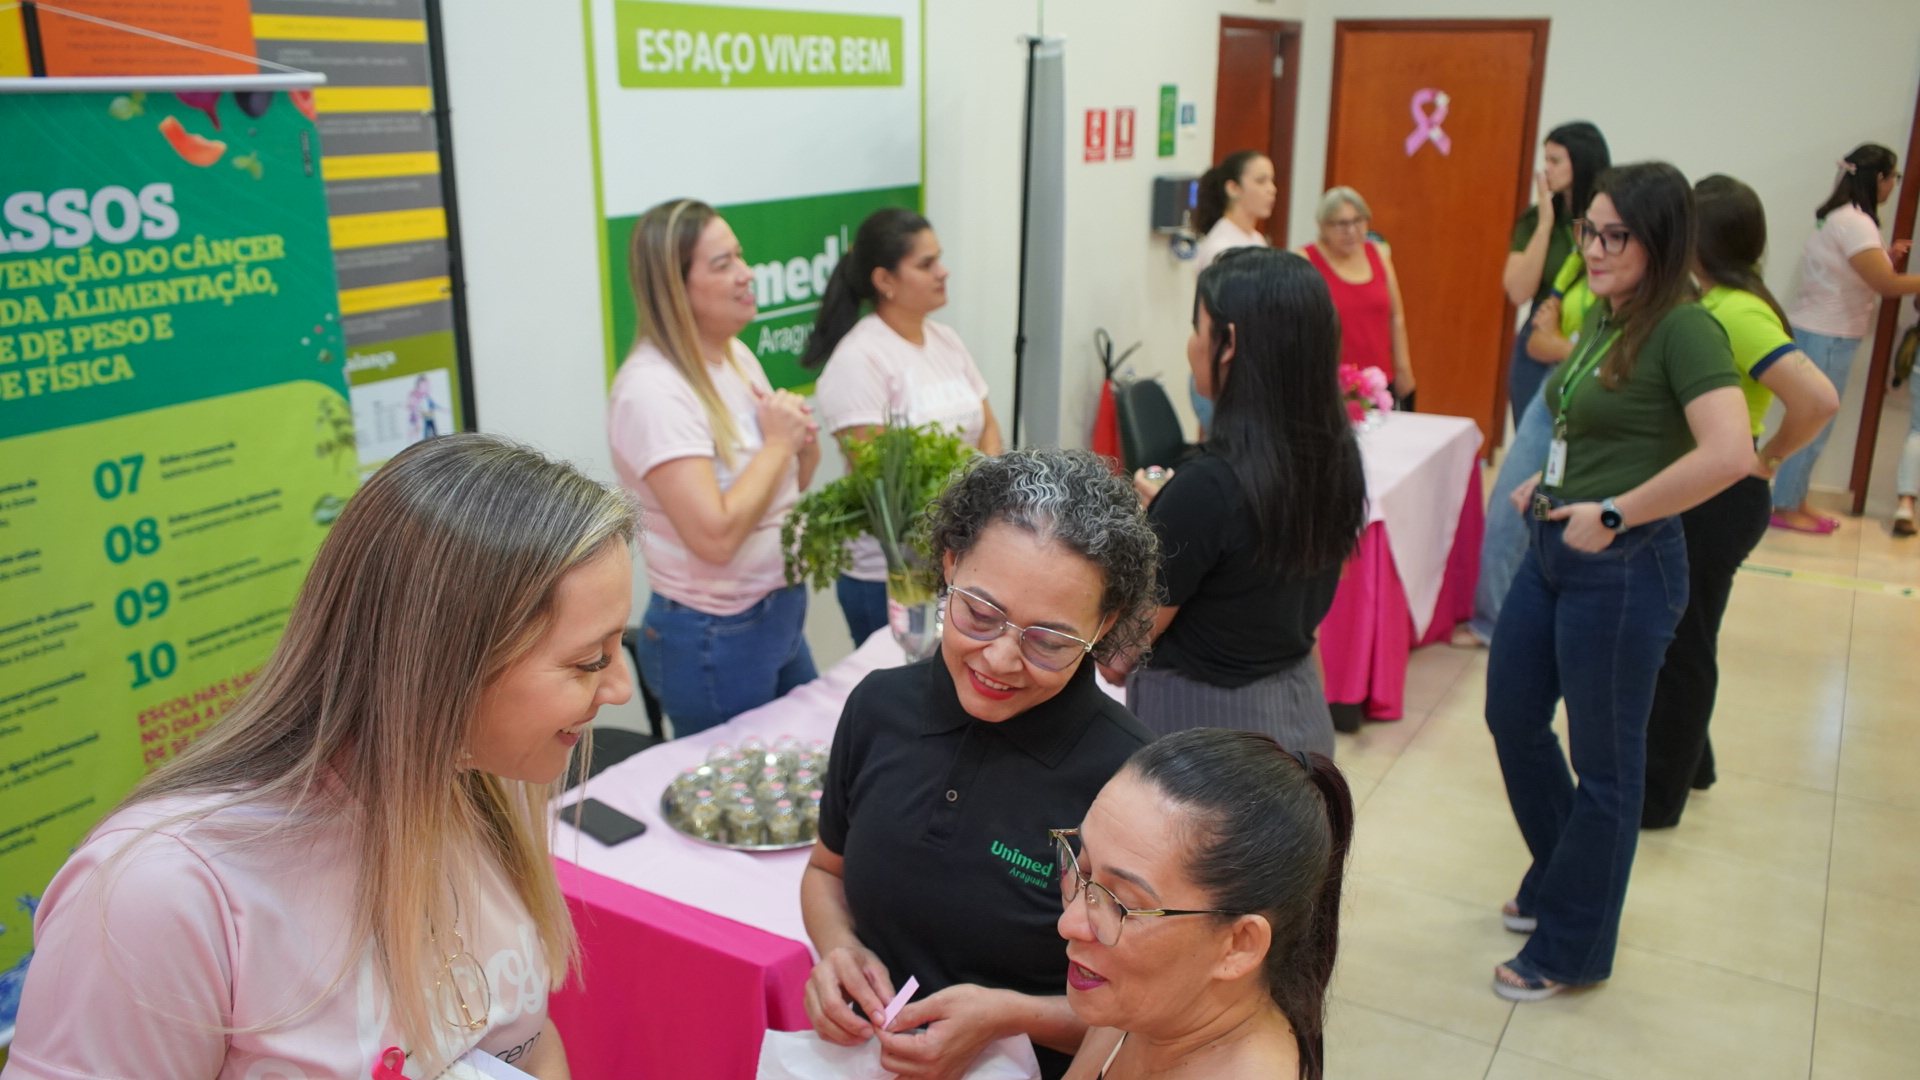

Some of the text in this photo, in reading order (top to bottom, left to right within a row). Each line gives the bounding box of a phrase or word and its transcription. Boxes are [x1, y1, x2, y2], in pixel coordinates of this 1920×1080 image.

[637, 28, 892, 86] ESPAÇO VIVER BEM
[0, 182, 180, 253] SSOS
[0, 234, 286, 292] ENÇÃO DO CÂNCER
[53, 264, 279, 321] ALIMENTAÇÃO,
[19, 328, 69, 361] DE
[70, 316, 150, 353] PESO
[152, 312, 174, 341] E
[26, 354, 135, 397] FÍSICA
[93, 453, 145, 501] 07
[104, 515, 162, 565] 08
[114, 580, 170, 628] 09
[126, 640, 178, 689] 10
[990, 840, 1054, 877] Unimed
[1009, 866, 1048, 888] Araguaia
